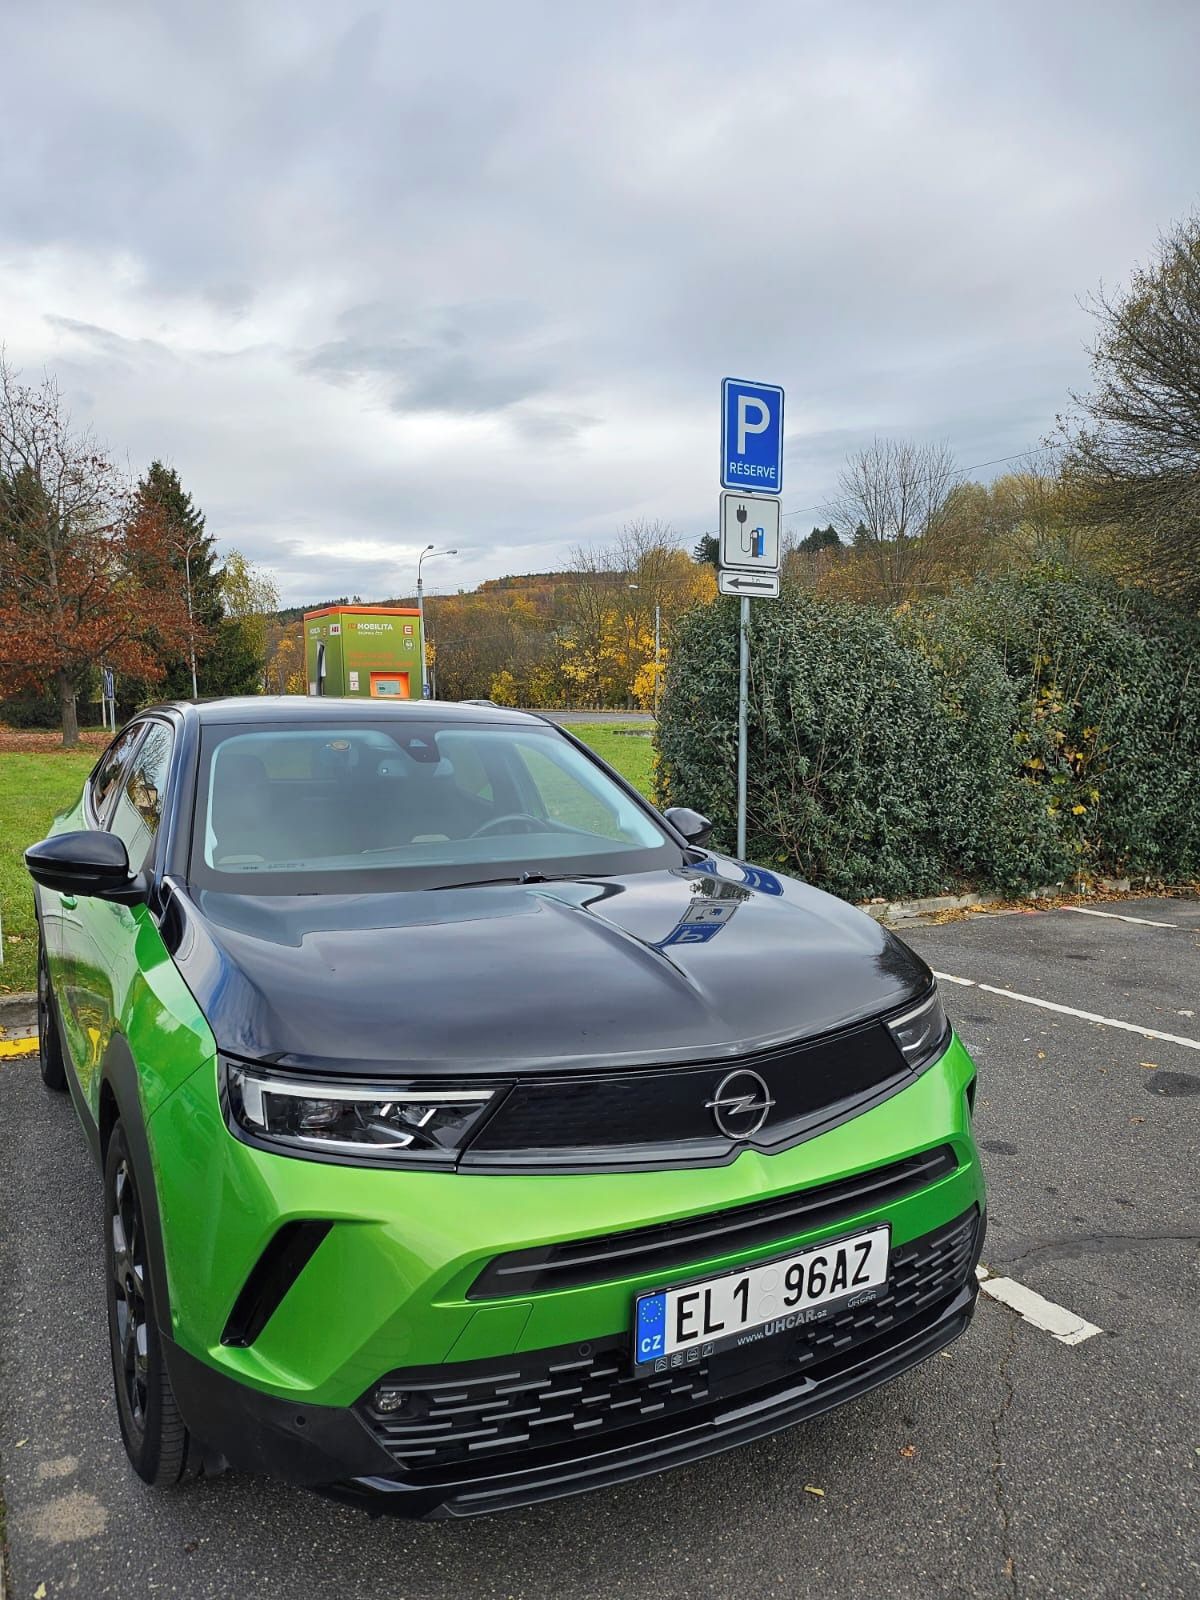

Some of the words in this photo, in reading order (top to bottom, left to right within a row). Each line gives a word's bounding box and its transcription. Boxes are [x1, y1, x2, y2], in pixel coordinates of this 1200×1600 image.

[737, 394, 771, 455] P
[729, 461, 776, 479] RÉSERVÉ
[783, 1239, 873, 1307] 96AZ
[847, 1293, 877, 1308] UHCAR
[641, 1334, 662, 1353] CZ
